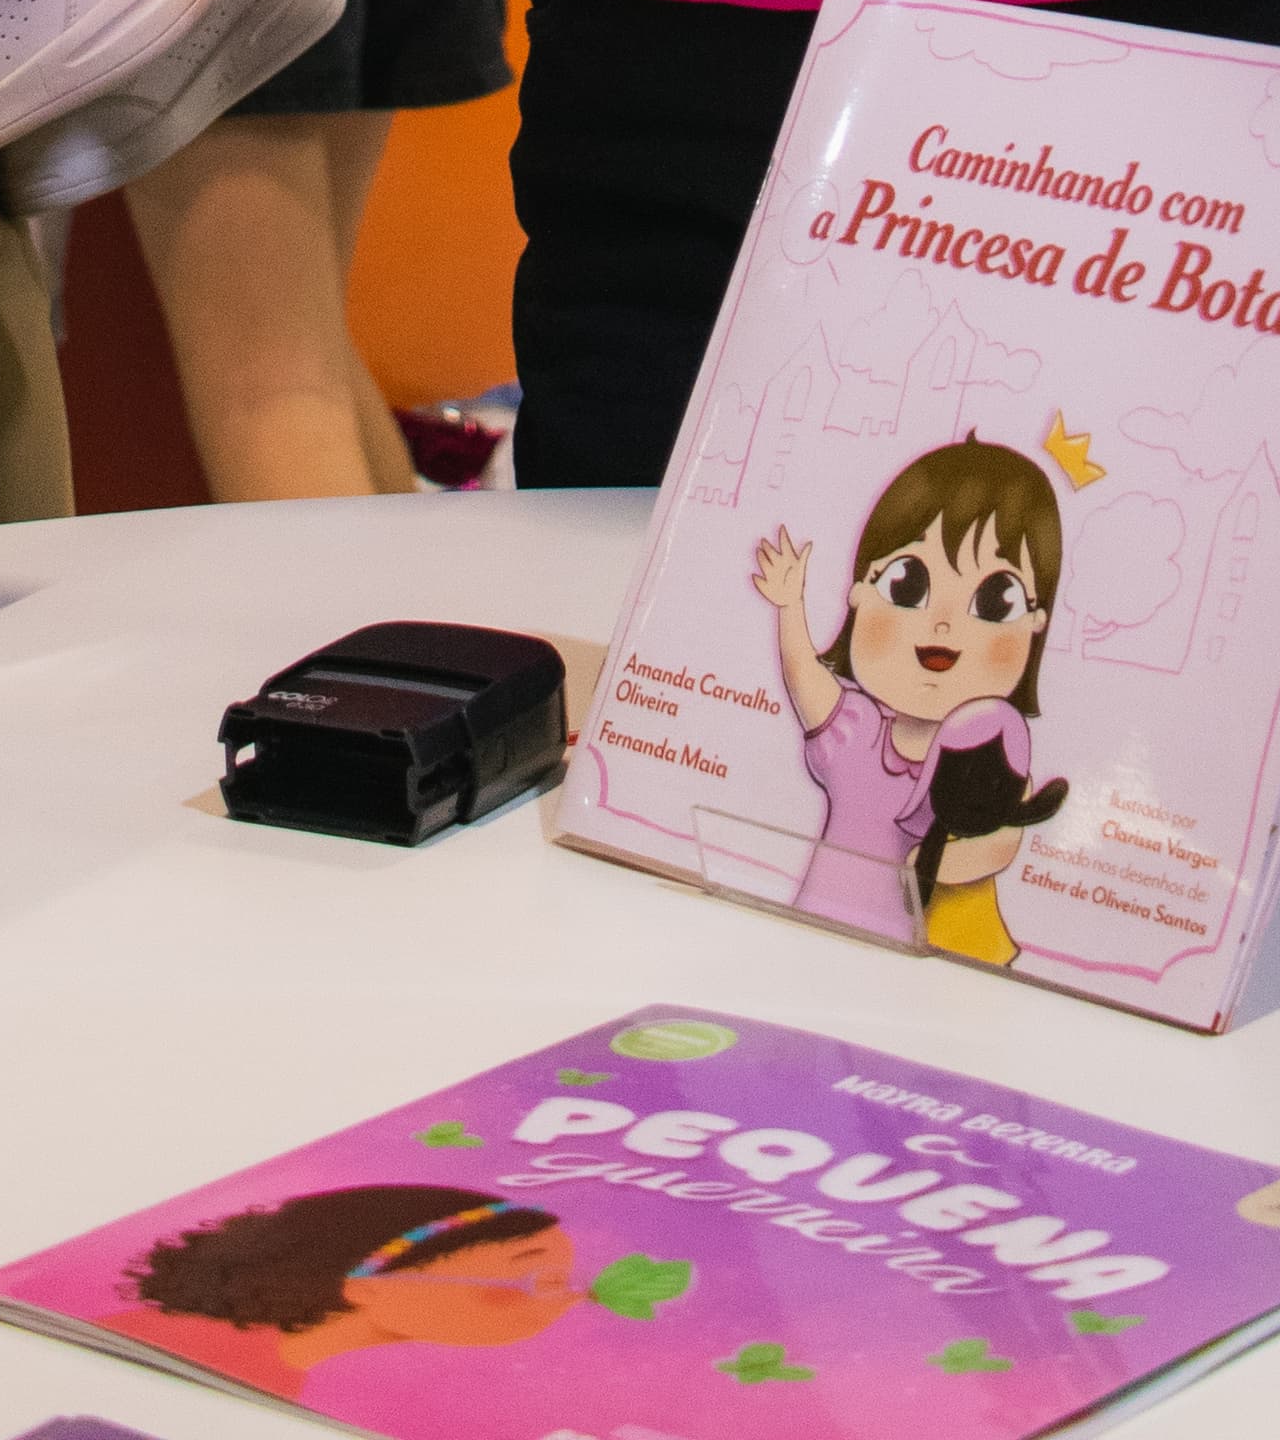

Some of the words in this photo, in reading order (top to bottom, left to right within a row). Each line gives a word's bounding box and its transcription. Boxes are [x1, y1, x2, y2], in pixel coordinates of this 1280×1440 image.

[909, 124, 1153, 214] Caminhando
[1159, 191, 1246, 234] com
[809, 207, 835, 240] a
[838, 178, 1067, 288] Princesa
[1073, 228, 1146, 303] de
[615, 679, 678, 717] Oliveira
[623, 652, 695, 692] Amanda
[700, 673, 781, 716] Carvalho
[599, 720, 677, 763] Fernanda
[680, 744, 728, 779] Maia
[1102, 819, 1162, 853] Clarissa
[1168, 836, 1218, 869] Vargas
[1171, 812, 1198, 830] por
[1030, 834, 1089, 866] Baseado
[1092, 857, 1116, 876] nos
[1119, 862, 1184, 896] desenhos
[1022, 864, 1068, 893] Esther
[1070, 880, 1088, 901] de
[1092, 885, 1151, 920] Oliveira
[1154, 904, 1208, 936] Santos
[497, 1151, 1010, 1297] guerreira
[511, 1096, 1171, 1301] PEQUENA
